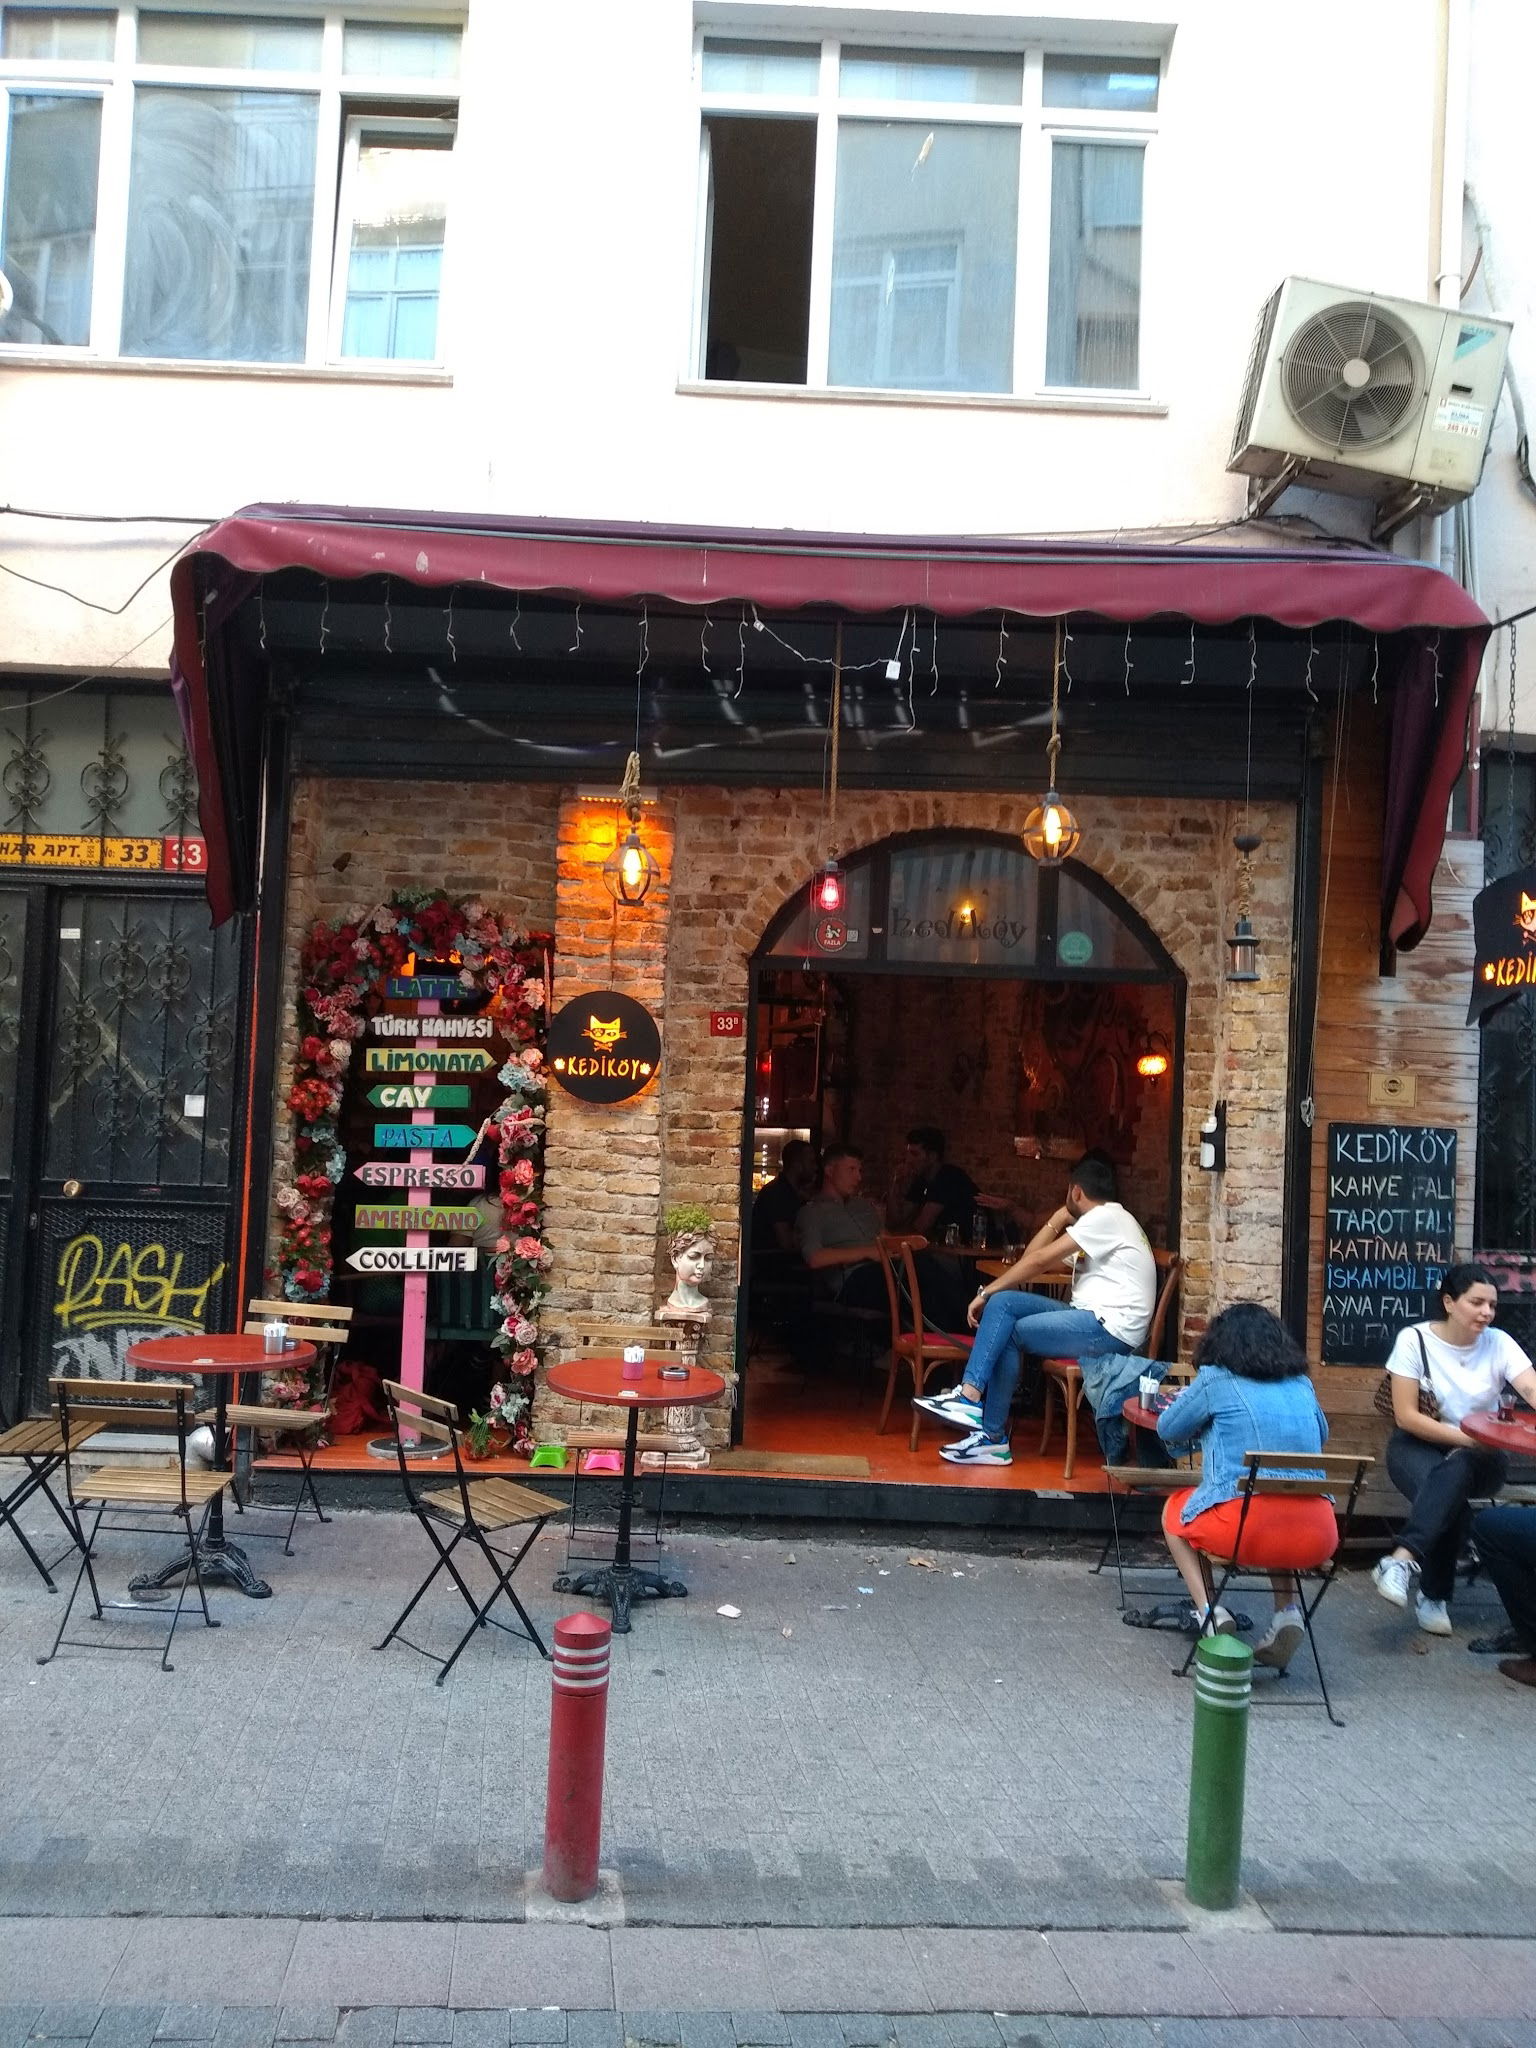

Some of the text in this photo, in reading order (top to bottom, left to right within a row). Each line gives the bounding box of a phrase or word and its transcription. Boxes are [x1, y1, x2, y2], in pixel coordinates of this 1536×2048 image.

[42, 843, 81, 858] APT.
[120, 844, 149, 862] 33
[171, 843, 202, 865] 33
[371, 1014, 494, 1038] TÜRK KAHVESİ
[371, 1049, 485, 1072] LİMONATA
[567, 1055, 640, 1080] KEDİKÖY
[383, 1127, 453, 1147] PASTA
[362, 1166, 475, 1188] ESPRESSO
[1330, 1175, 1455, 1200] KAHVE FALI
[356, 1207, 480, 1230] AMERİCANO
[1328, 1207, 1411, 1235] TAROT
[1415, 1241, 1454, 1264] FALI
[1323, 1294, 1426, 1319] AYNA FALI
